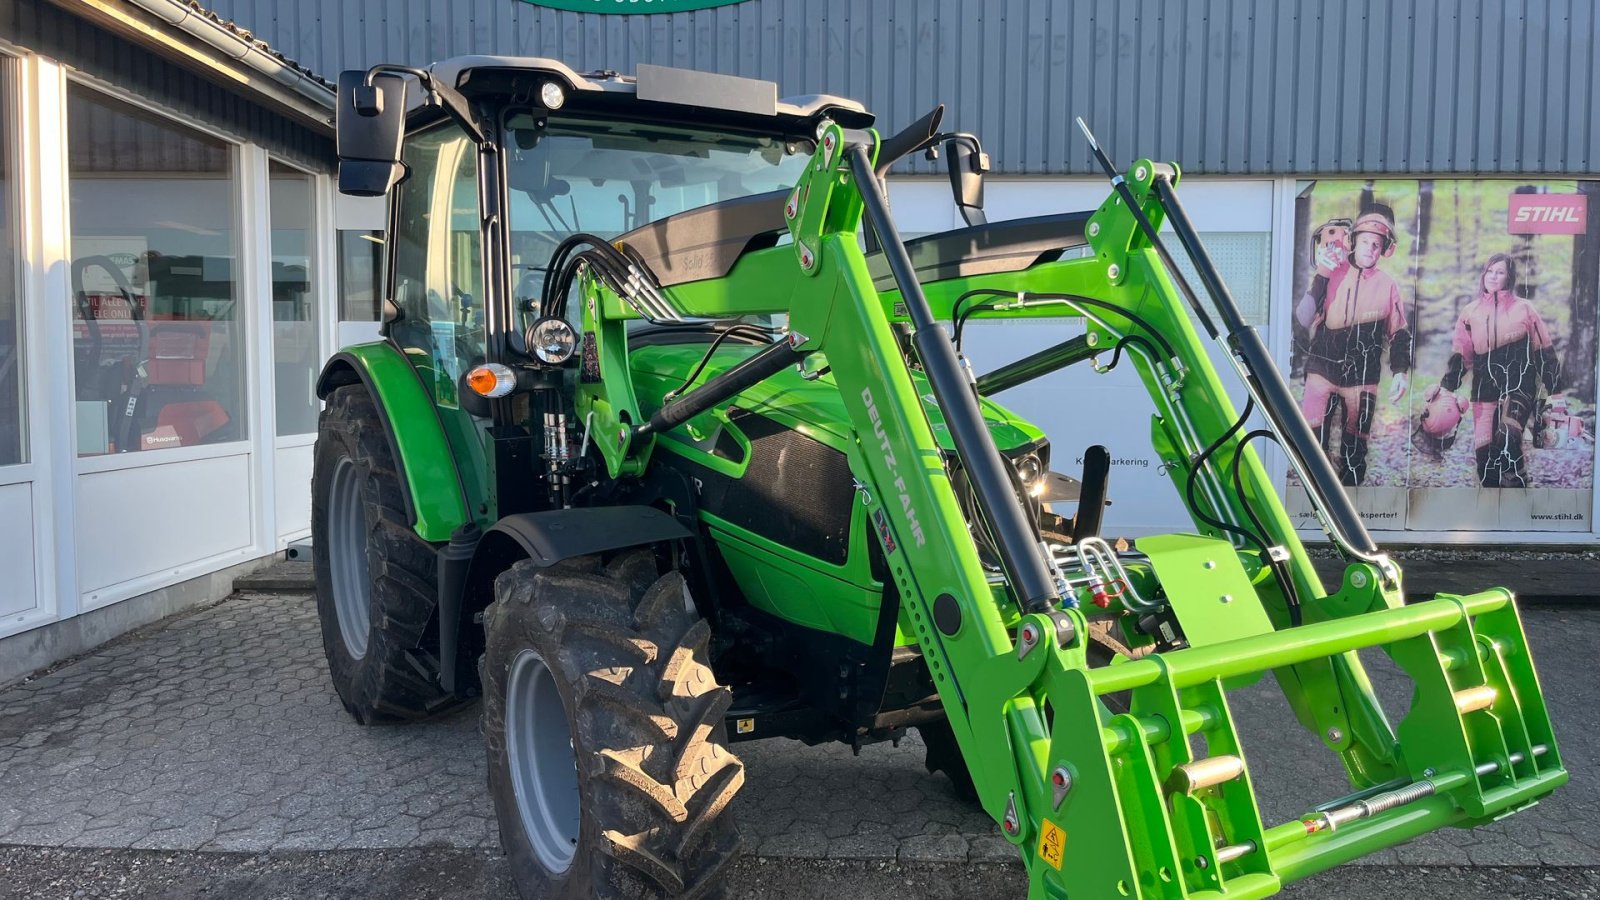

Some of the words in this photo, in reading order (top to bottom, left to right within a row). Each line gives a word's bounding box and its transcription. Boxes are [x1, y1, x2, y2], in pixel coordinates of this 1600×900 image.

[1514, 206, 1579, 222] STIHL
[102, 297, 123, 306] ALLE
[861, 386, 925, 548] DEUTZ-FAHR
[1530, 513, 1584, 521] www.stihl.dk
